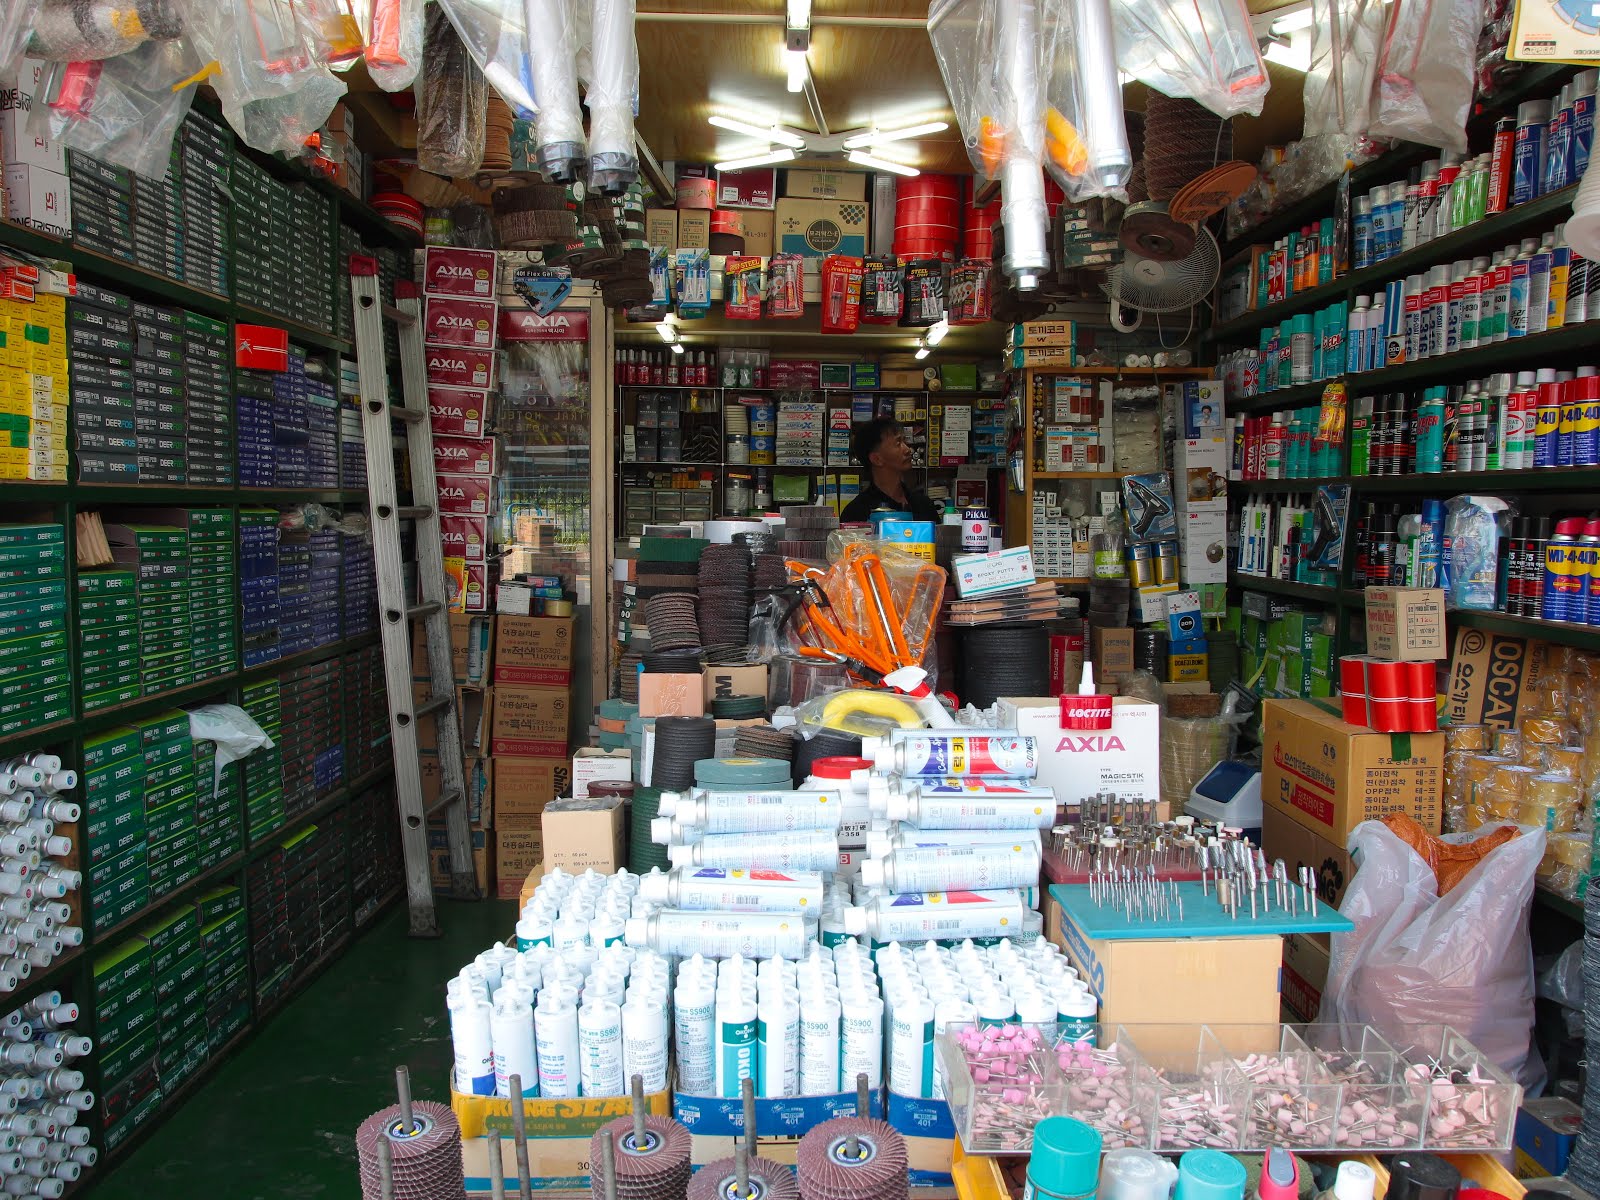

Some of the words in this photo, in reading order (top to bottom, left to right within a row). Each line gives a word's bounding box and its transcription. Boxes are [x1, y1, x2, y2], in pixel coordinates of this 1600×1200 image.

[32, 219, 73, 238] TRISTONE
[436, 266, 474, 276] AXIA
[436, 316, 474, 328] AXIA
[521, 315, 570, 327] AXIA
[1028, 326, 1065, 334] 토끼코크
[429, 358, 466, 370] AXIA
[430, 405, 463, 417] AXIA
[434, 448, 468, 458] AXIA
[438, 487, 465, 498] XIA
[1068, 708, 1112, 718] LOCTITE
[1055, 736, 1126, 752] AXIA
[841, 855, 848, 864] B
[690, 1006, 710, 1015] SS900
[557, 1100, 632, 1118] SEA
[682, 1116, 695, 1124] 401
[917, 1119, 931, 1127] 401
[578, 1162, 590, 1170] 30
